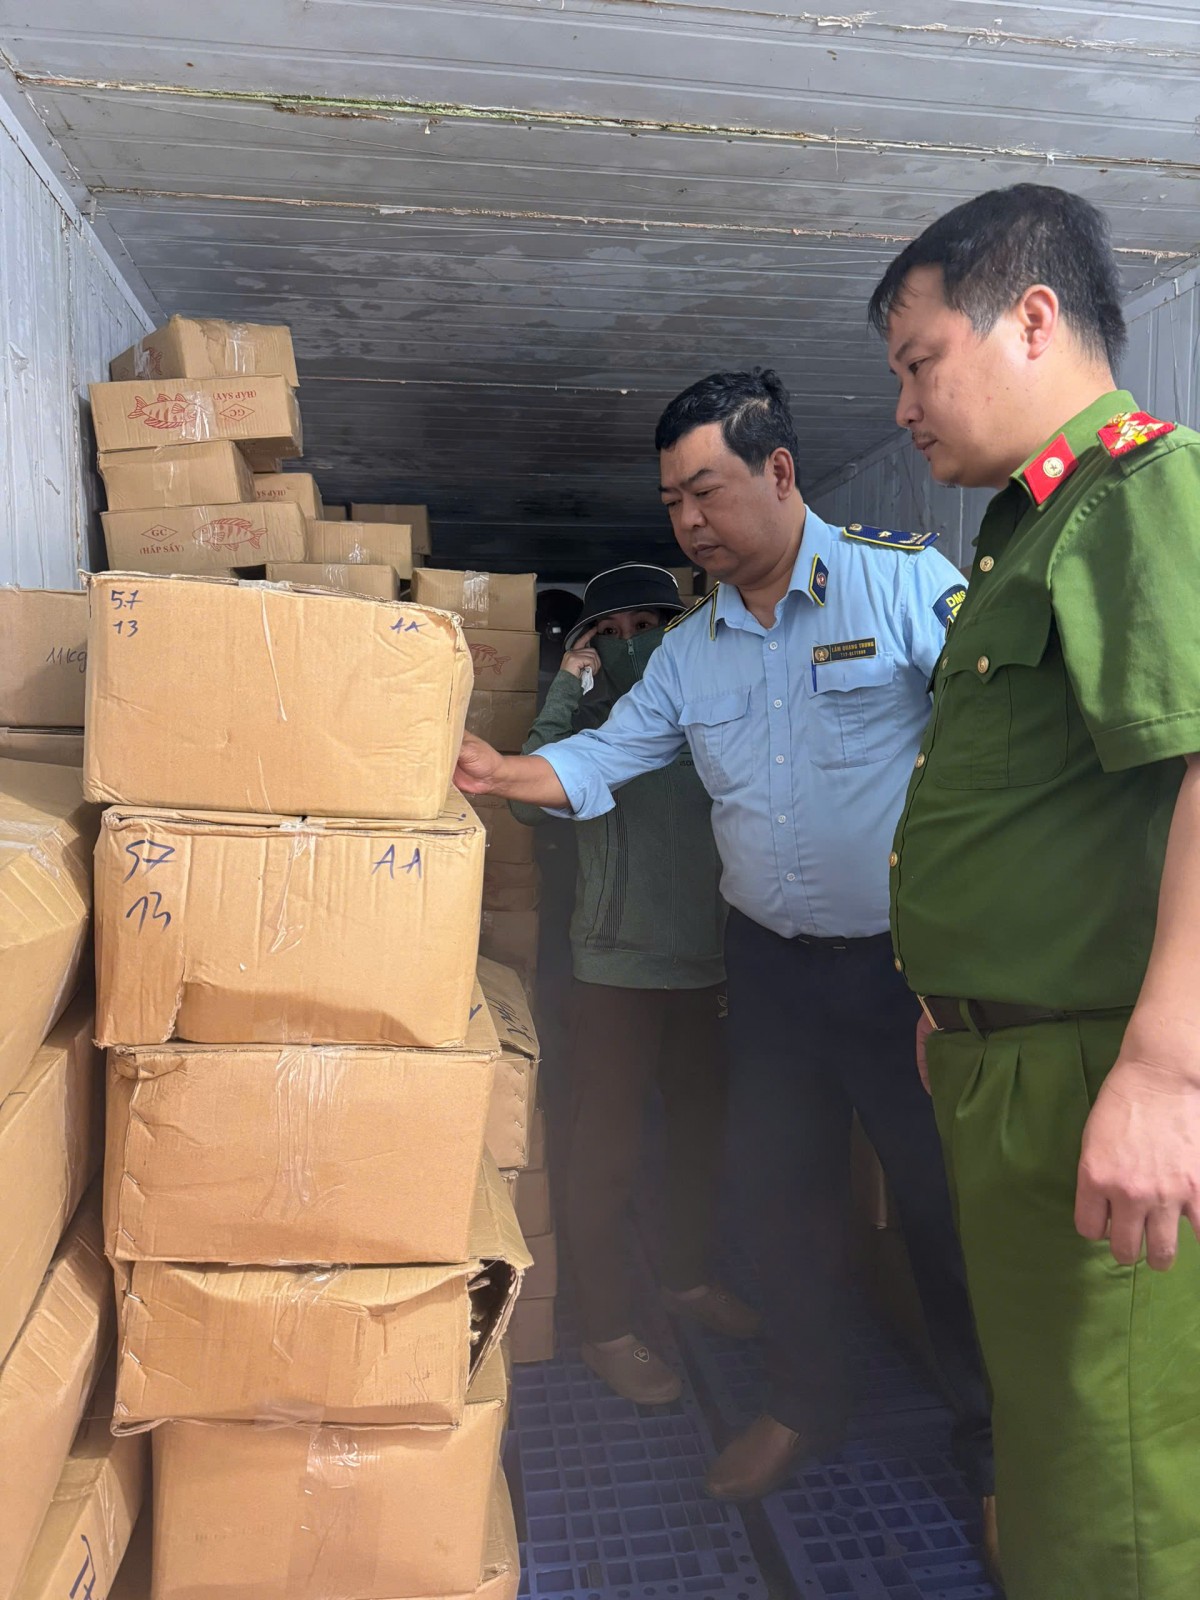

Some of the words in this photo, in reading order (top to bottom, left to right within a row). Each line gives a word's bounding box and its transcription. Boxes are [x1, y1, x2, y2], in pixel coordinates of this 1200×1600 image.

[229, 409, 245, 417] GC
[151, 529, 168, 537] GC
[945, 590, 967, 608] DMS
[112, 619, 139, 638] 13
[370, 843, 422, 880] AA
[125, 891, 172, 936] 13
